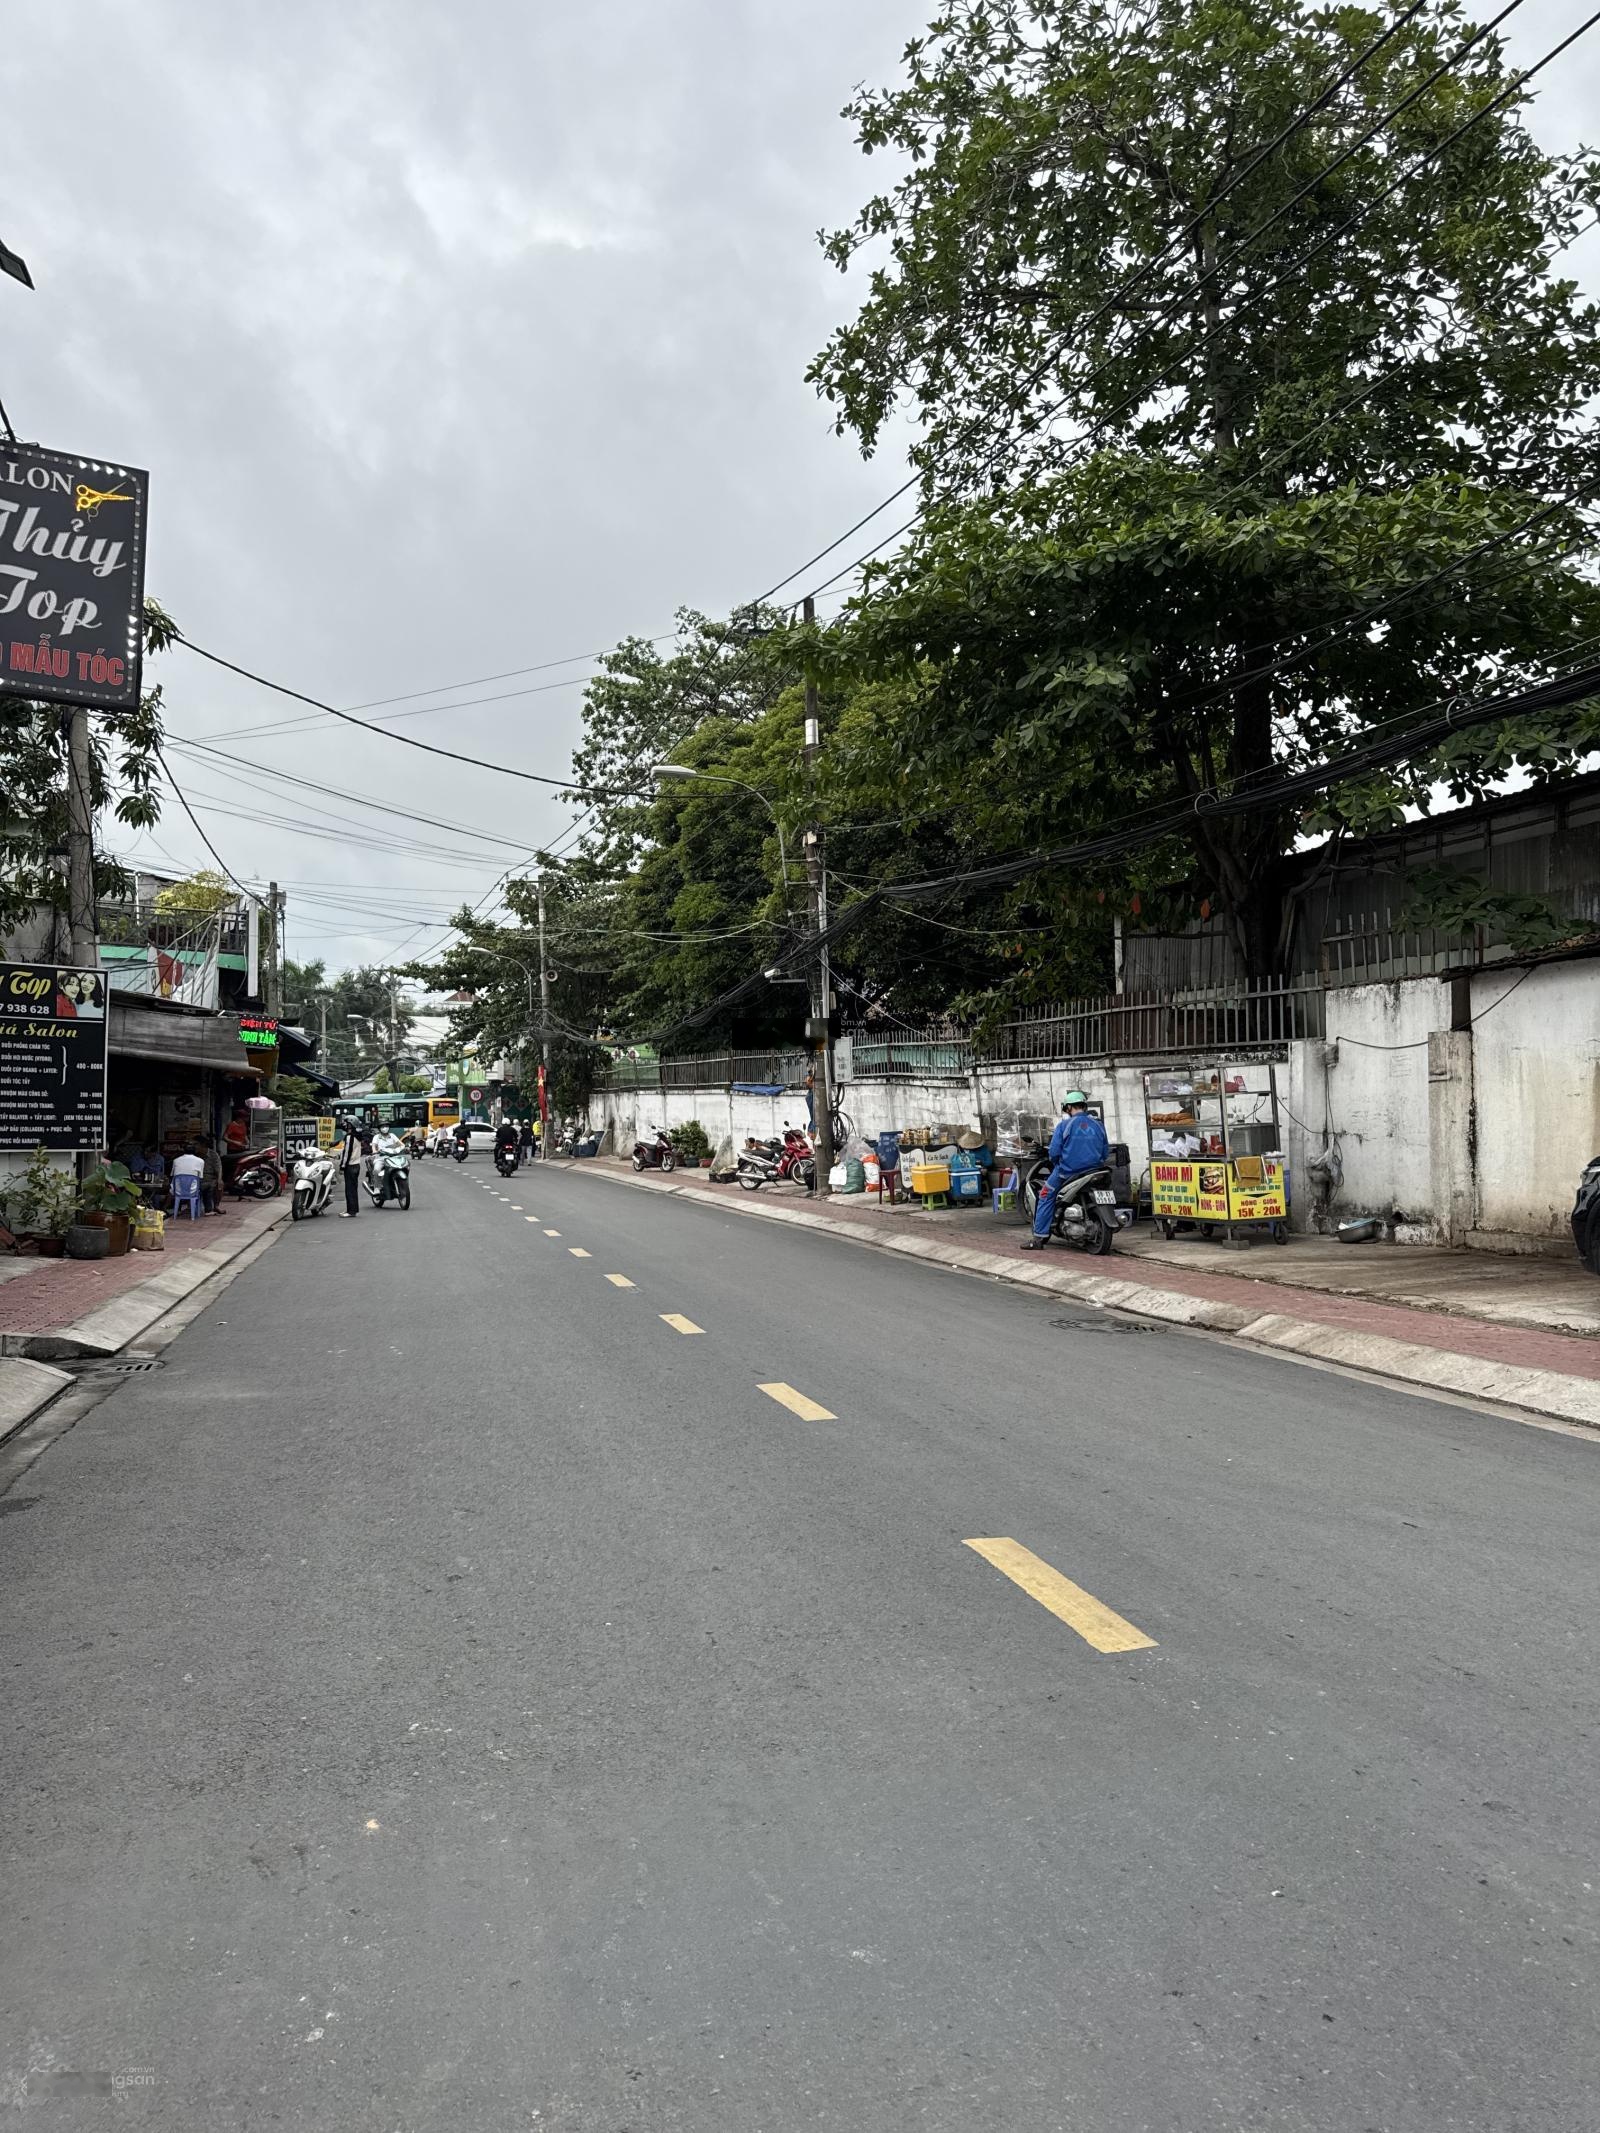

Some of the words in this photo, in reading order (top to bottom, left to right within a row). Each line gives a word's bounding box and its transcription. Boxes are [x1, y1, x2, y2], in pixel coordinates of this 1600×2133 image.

[0, 461, 75, 496] LON
[0, 564, 102, 636] Top
[10, 633, 70, 678] MẪU
[77, 648, 125, 686] TÓC
[9, 970, 52, 1001] Top
[7, 1003, 27, 1013] 938
[30, 1005, 50, 1015] 628
[24, 1021, 79, 1039] Salon
[286, 1123, 295, 1134] CẮT
[295, 1123, 304, 1134] TÓC
[304, 1124, 316, 1134] NAM
[1155, 1164, 1179, 1182] BÁNH
[1181, 1164, 1193, 1182] MÌ
[1160, 1204, 1173, 1214] 15K
[1178, 1205, 1193, 1216] 20K
[1237, 1207, 1255, 1218] 15K
[1263, 1205, 1282, 1216] 20K
